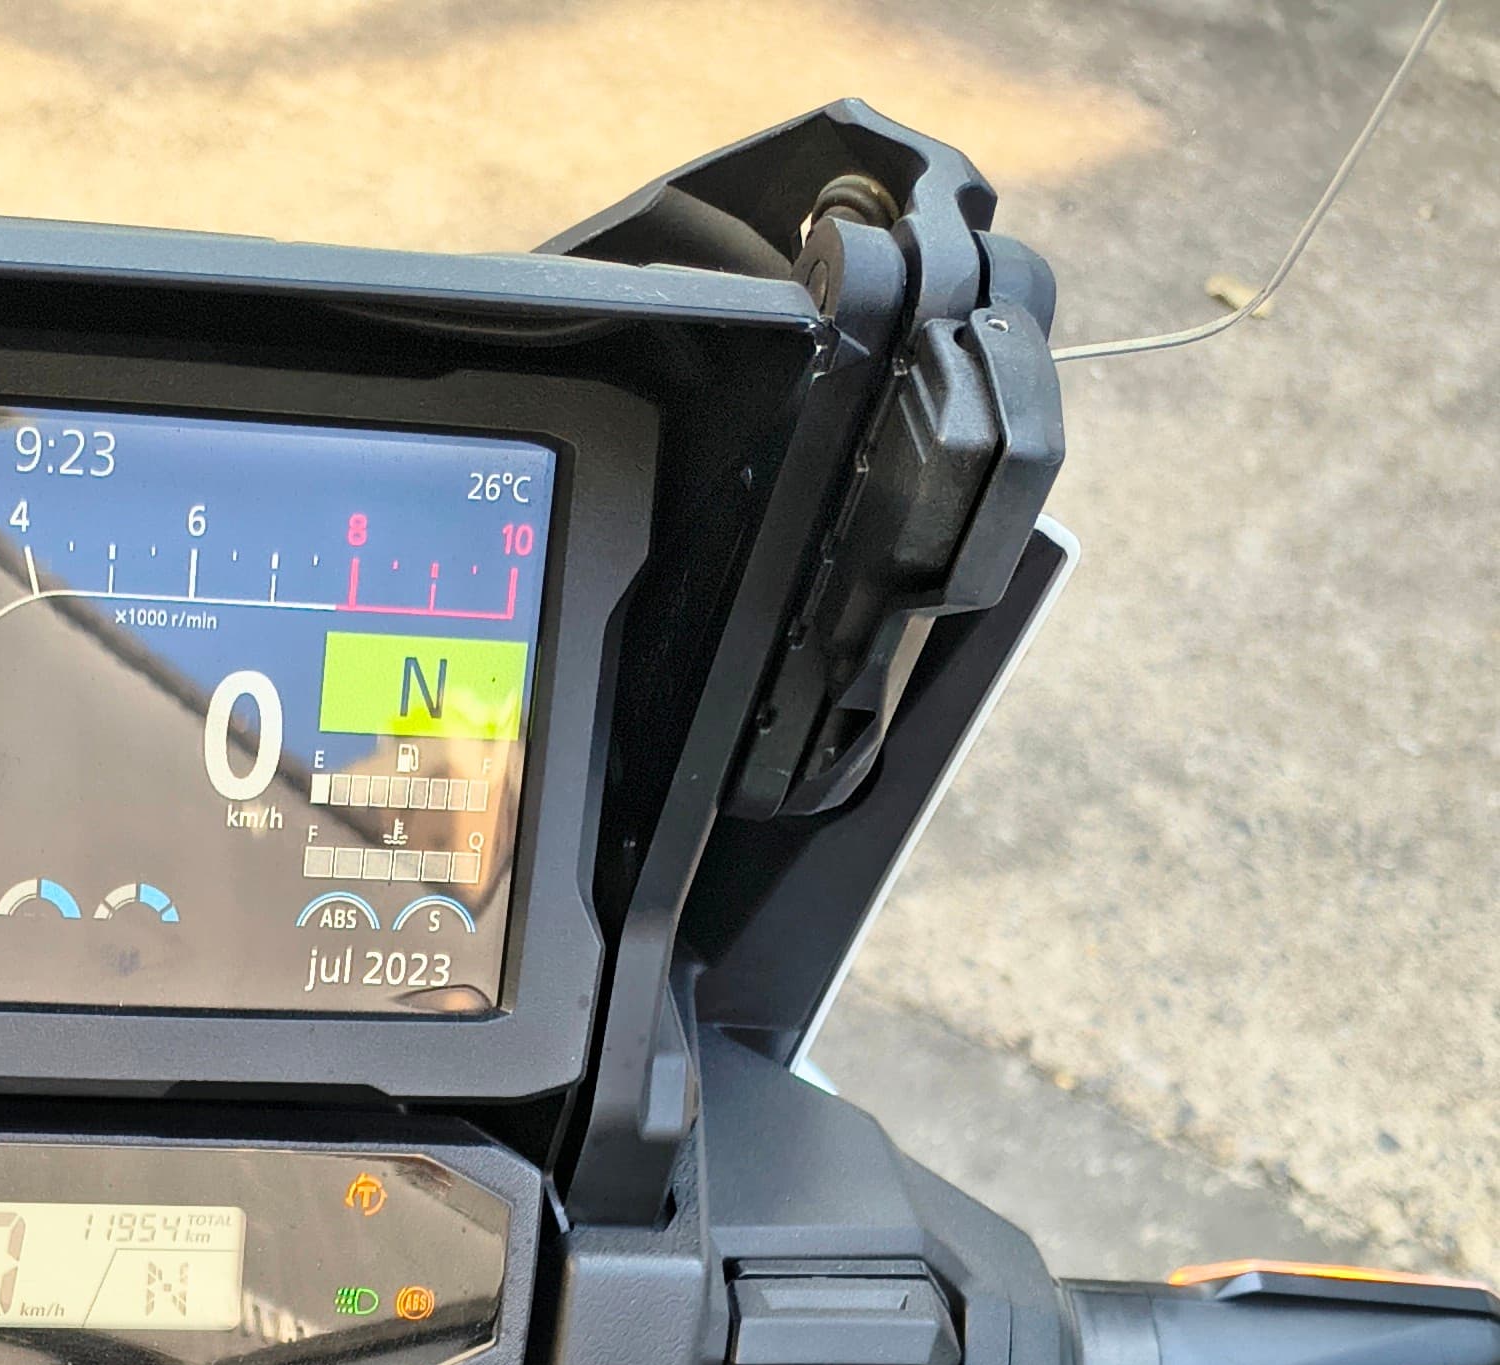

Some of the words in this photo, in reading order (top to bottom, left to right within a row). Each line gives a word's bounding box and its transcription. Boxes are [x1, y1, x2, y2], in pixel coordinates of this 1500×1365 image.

[15, 426, 116, 478] 9:23
[467, 473, 531, 503] 26°C
[9, 499, 31, 533] 4
[187, 505, 207, 537] 6
[347, 513, 368, 547] 8
[501, 523, 534, 557] 10
[171, 611, 218, 631] r/min
[399, 657, 448, 720] N
[204, 670, 283, 801] 0
[314, 750, 325, 769] E
[227, 804, 284, 830] km/h
[307, 824, 319, 843] F
[468, 832, 485, 852] Q
[319, 908, 358, 930] ABS
[428, 910, 441, 932] S
[305, 947, 352, 991] jul
[362, 951, 452, 988] 2023
[85, 1212, 182, 1243] 11954
[187, 1214, 233, 1227] TOTAL
[185, 1229, 212, 1244] km
[19, 1301, 66, 1319] km/h
